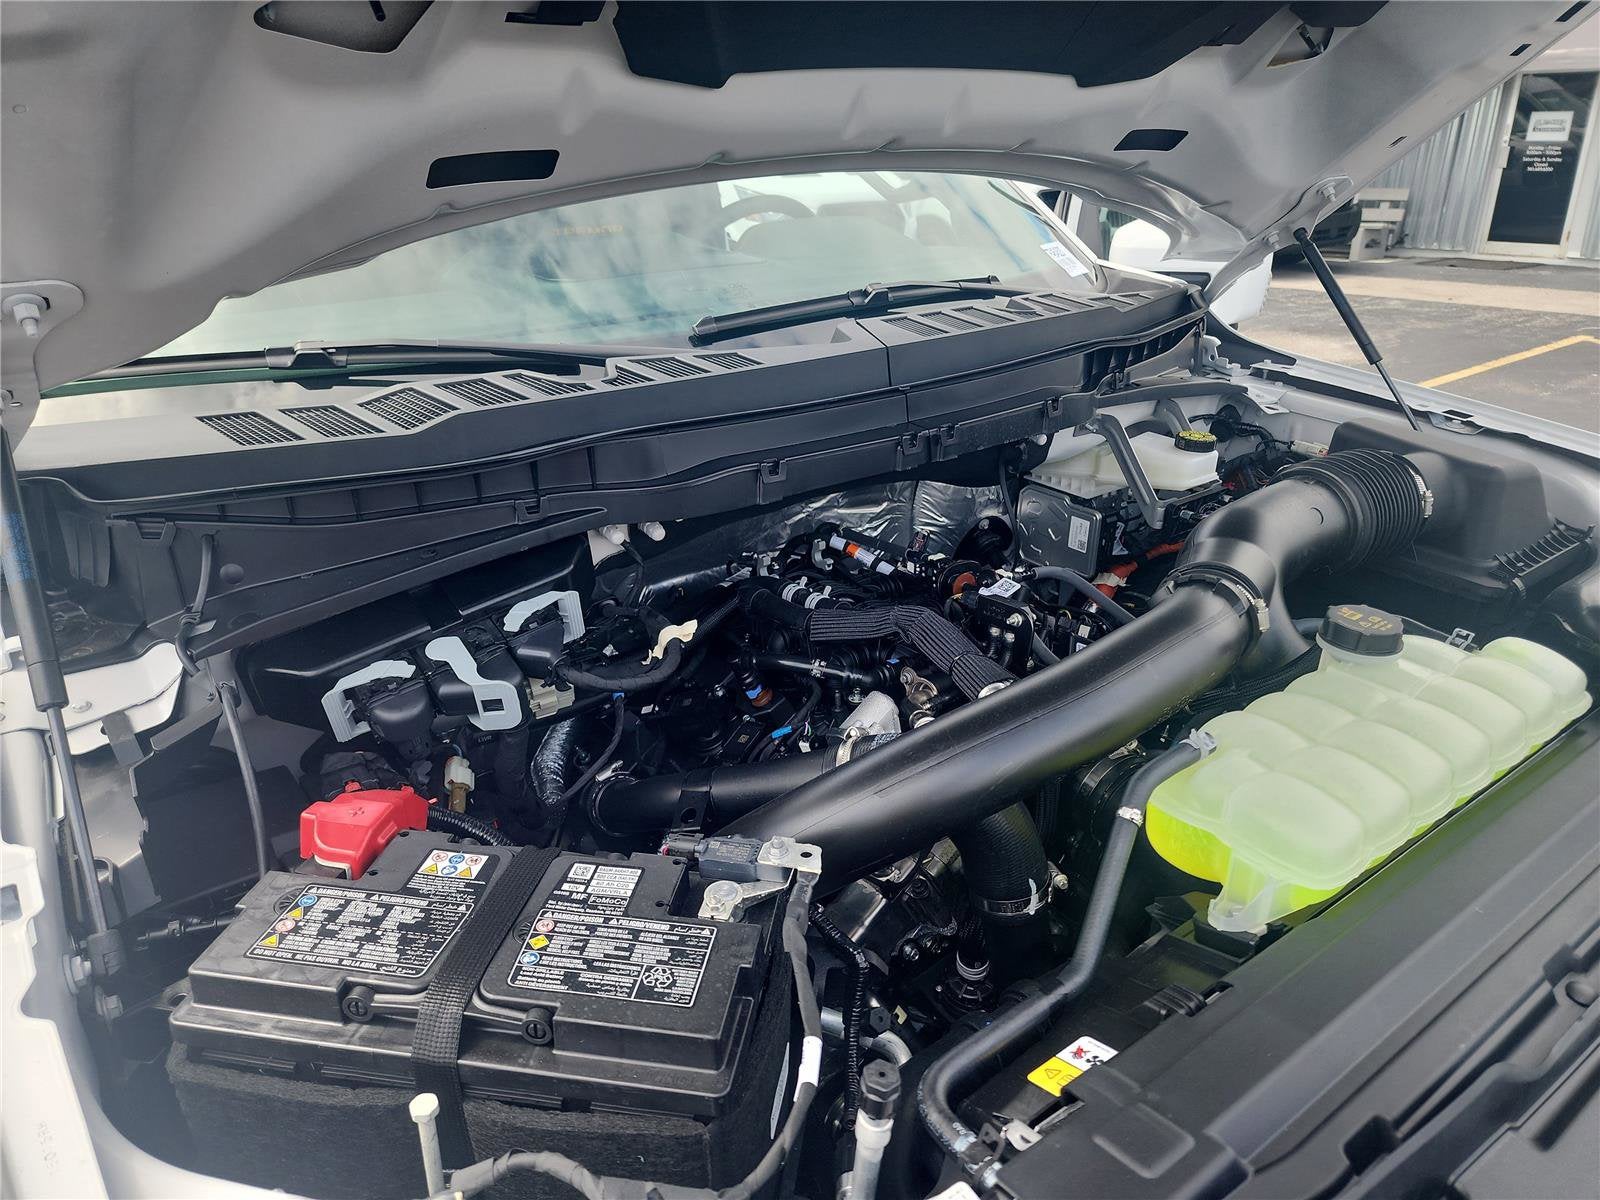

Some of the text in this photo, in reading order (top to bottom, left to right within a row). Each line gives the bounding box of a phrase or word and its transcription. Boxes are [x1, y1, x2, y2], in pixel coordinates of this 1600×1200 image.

[318, 888, 366, 898] DANGER/POISON
[590, 897, 626, 905] FoMoCo
[553, 912, 670, 930] DANGER/POISON PELIGRO/VENENO
